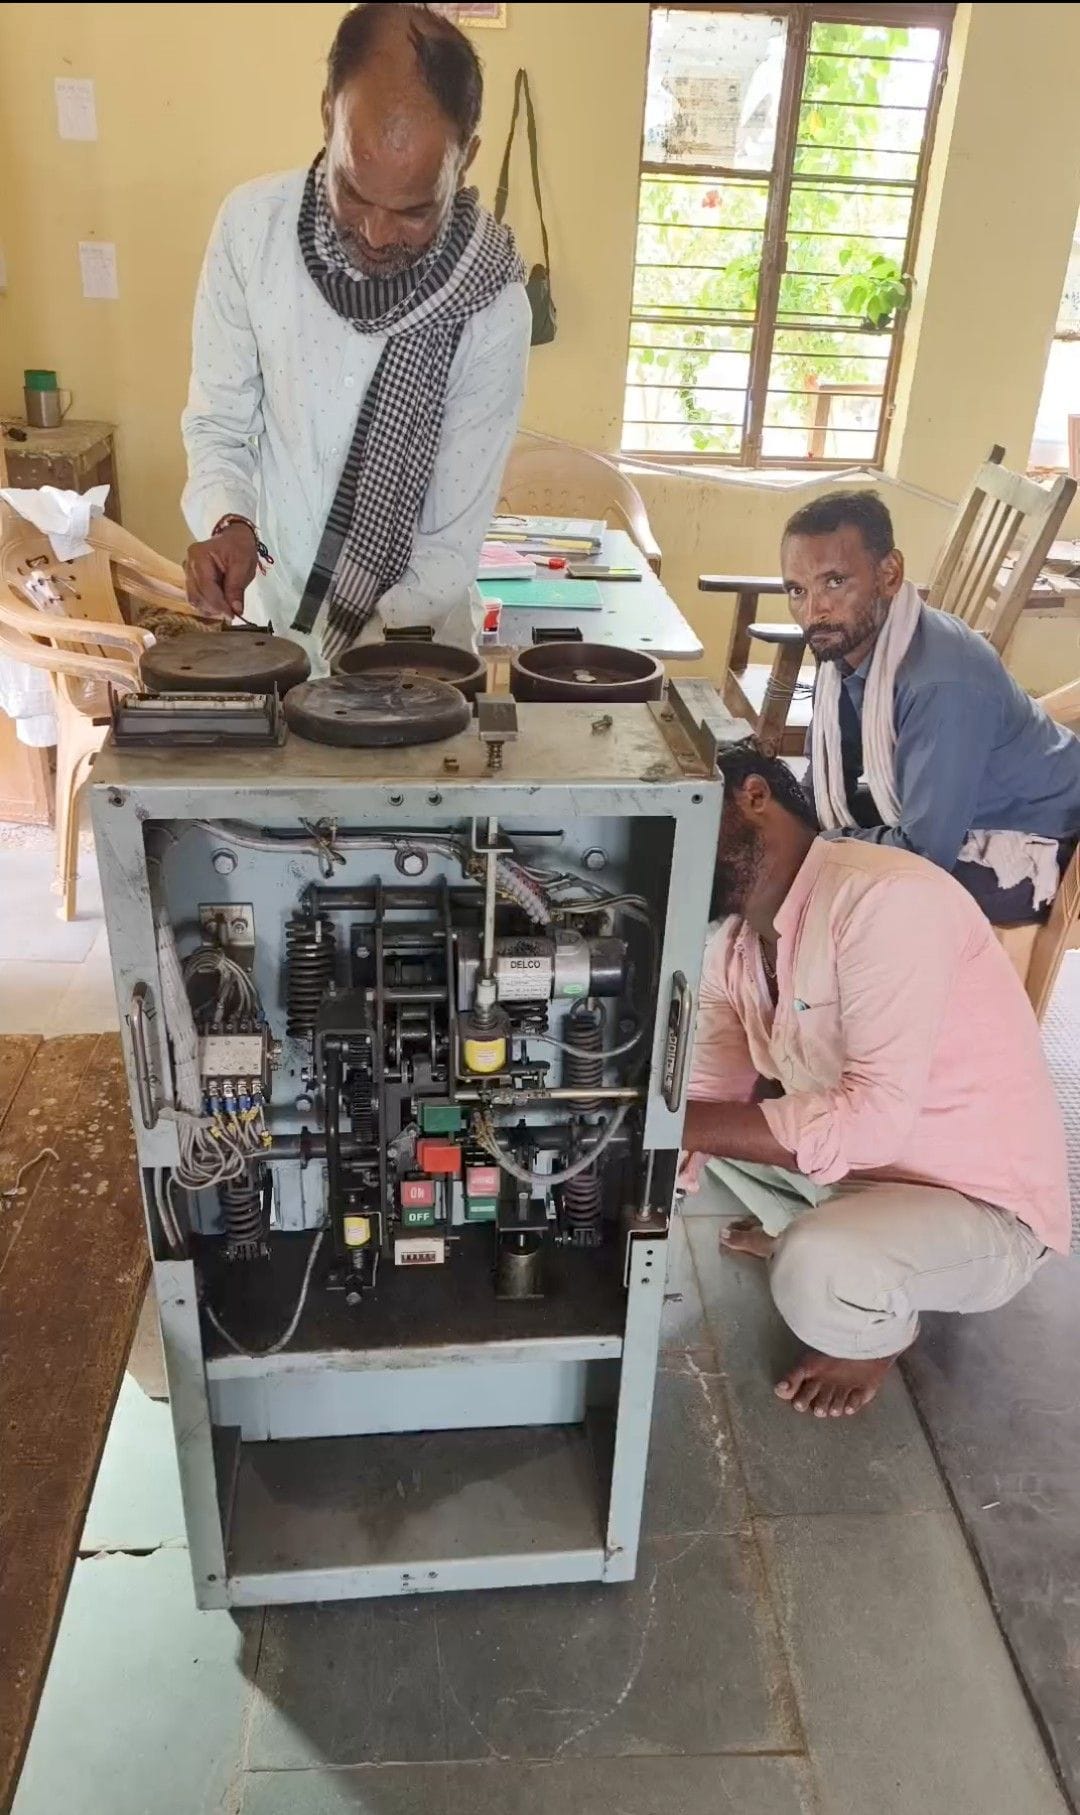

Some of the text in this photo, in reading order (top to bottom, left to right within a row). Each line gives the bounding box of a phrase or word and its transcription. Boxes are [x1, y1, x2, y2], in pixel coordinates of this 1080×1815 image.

[510, 960, 541, 969] DELCO
[410, 1186, 425, 1199] ON
[408, 1212, 430, 1222] OFF
